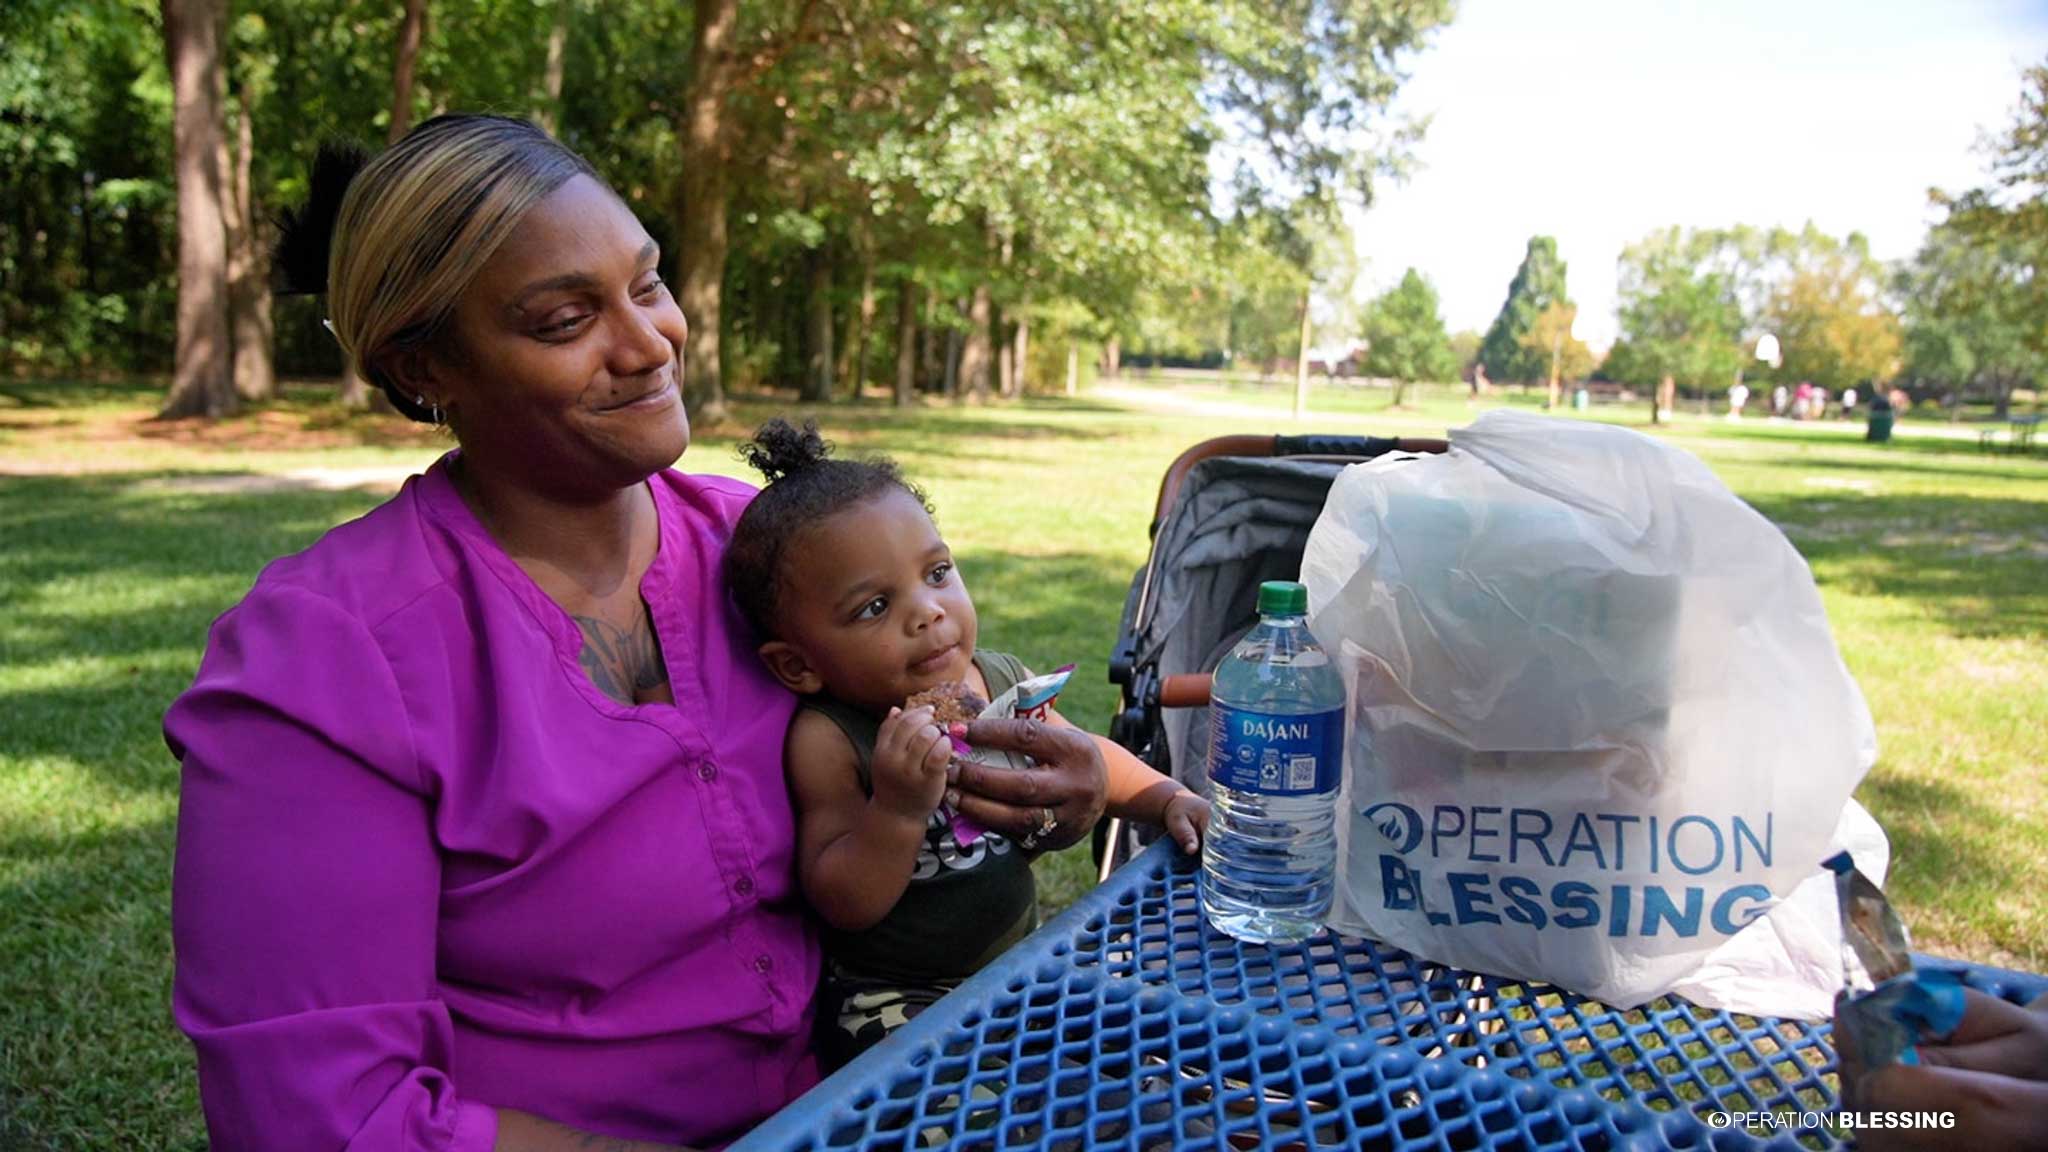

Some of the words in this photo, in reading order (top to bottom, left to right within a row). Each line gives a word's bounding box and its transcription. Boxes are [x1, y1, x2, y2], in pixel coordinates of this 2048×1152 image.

[1243, 719, 1309, 742] DASANI
[1362, 802, 1772, 875] OPERATION
[1379, 854, 1774, 937] BLESSING
